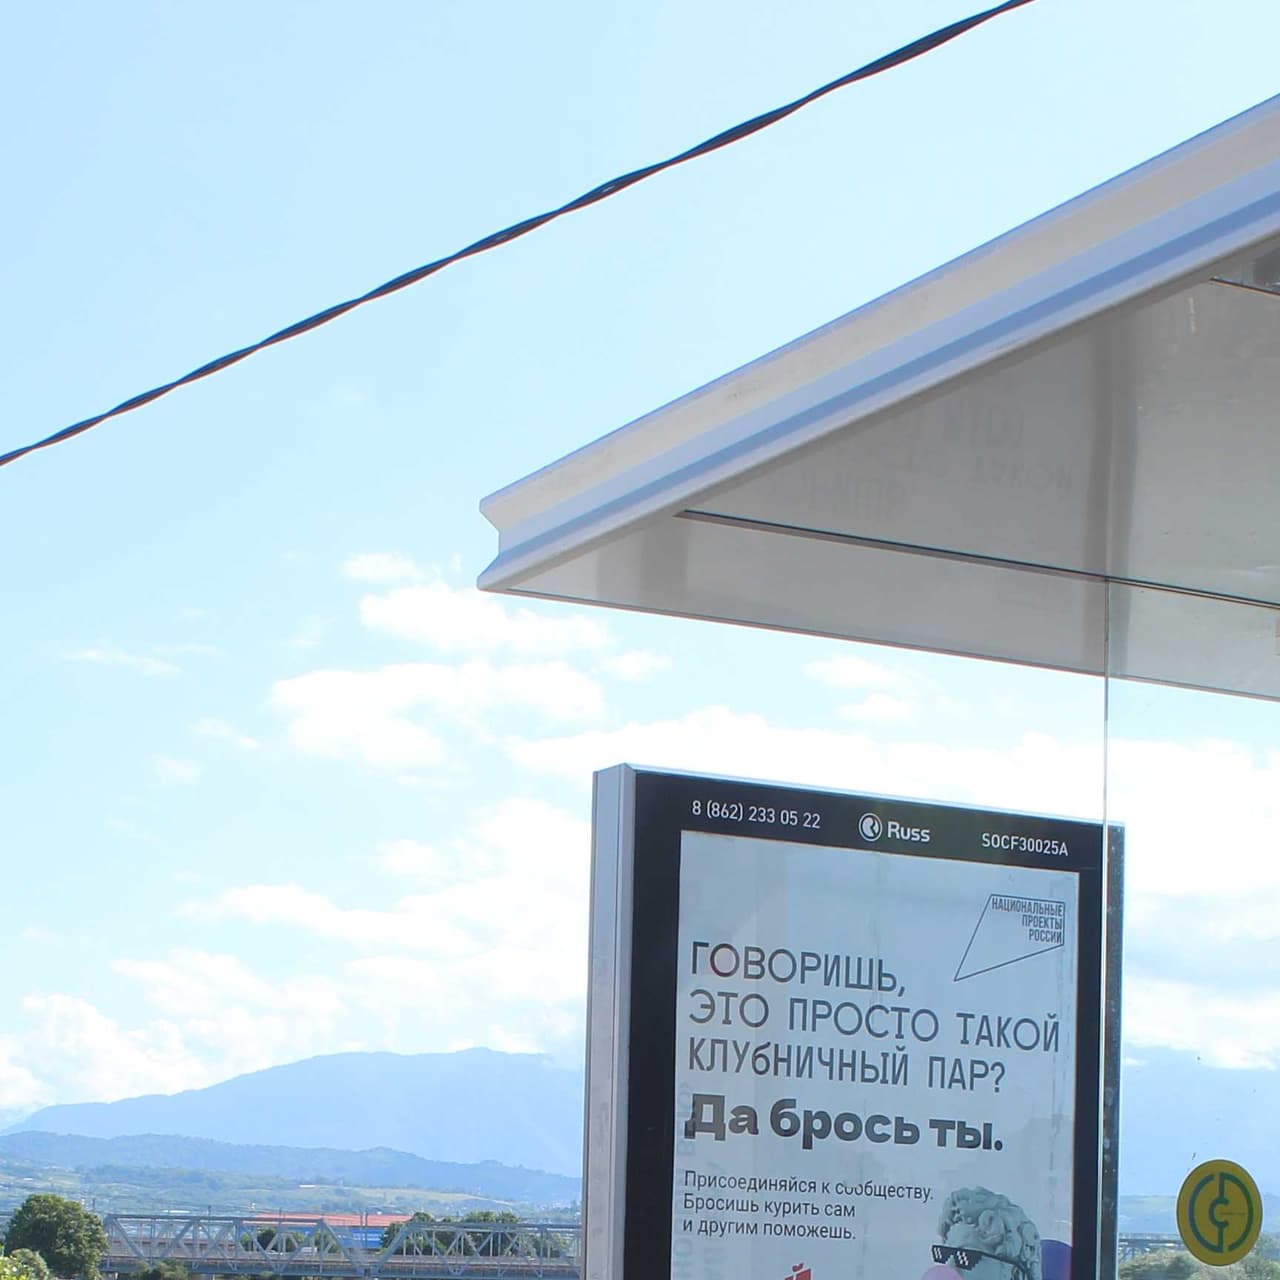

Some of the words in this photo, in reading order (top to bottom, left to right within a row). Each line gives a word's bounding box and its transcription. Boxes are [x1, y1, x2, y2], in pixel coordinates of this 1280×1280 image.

[691, 800, 701, 815] 8
[706, 800, 744, 822] (862)
[748, 807, 776, 824] 233
[780, 809, 798, 827] 05
[803, 812, 821, 829] 22
[888, 820, 930, 843] Russ
[992, 898, 1063, 917] НАЦИОНАЛЬНЫЕ
[1022, 914, 1063, 931] ПРОЕКТЫ
[1029, 928, 1062, 944] РОССИИ
[691, 941, 906, 997] ГОВОРИШЬ,
[689, 988, 769, 1028] ЭТО
[789, 997, 940, 1042] ПРОСТО
[956, 1012, 1061, 1053] ТАКОЙ
[928, 1056, 1006, 1093] ПАР?
[684, 1093, 759, 1141] Да
[769, 1098, 920, 1150] брось
[929, 1117, 1004, 1151] ты.
[684, 1170, 817, 1194] Присоединяйся
[822, 1182, 830, 1194] к
[683, 1192, 759, 1213] Бросишь
[764, 1200, 820, 1218] курить
[824, 1202, 855, 1217] сам
[683, 1219, 692, 1232] и
[697, 1219, 758, 1238] другим
[763, 1222, 856, 1240] поможешь.
